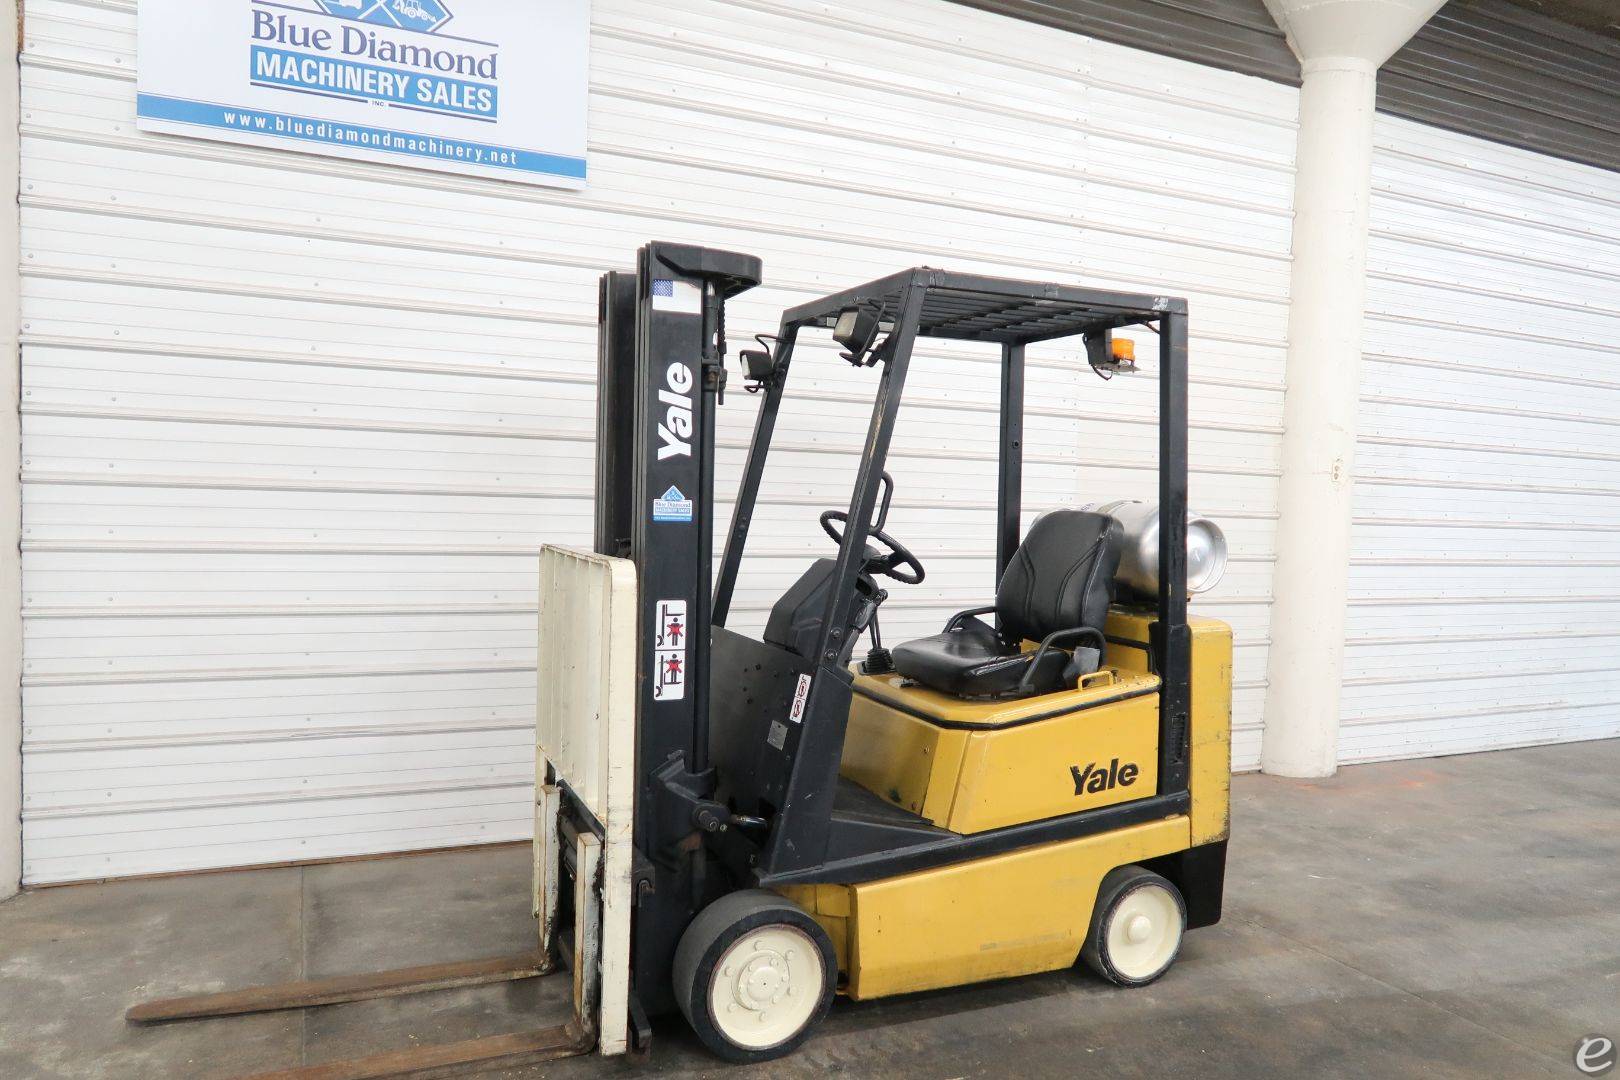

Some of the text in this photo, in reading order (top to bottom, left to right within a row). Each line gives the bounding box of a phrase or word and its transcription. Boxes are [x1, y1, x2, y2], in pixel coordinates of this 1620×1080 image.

[251, 9, 498, 80] Blue Diamond
[256, 51, 492, 112] MACHINERY SALES
[223, 111, 518, 165] www.bluediamondmachinery.net
[657, 361, 693, 461] Yale
[1070, 758, 1139, 796] Yale
